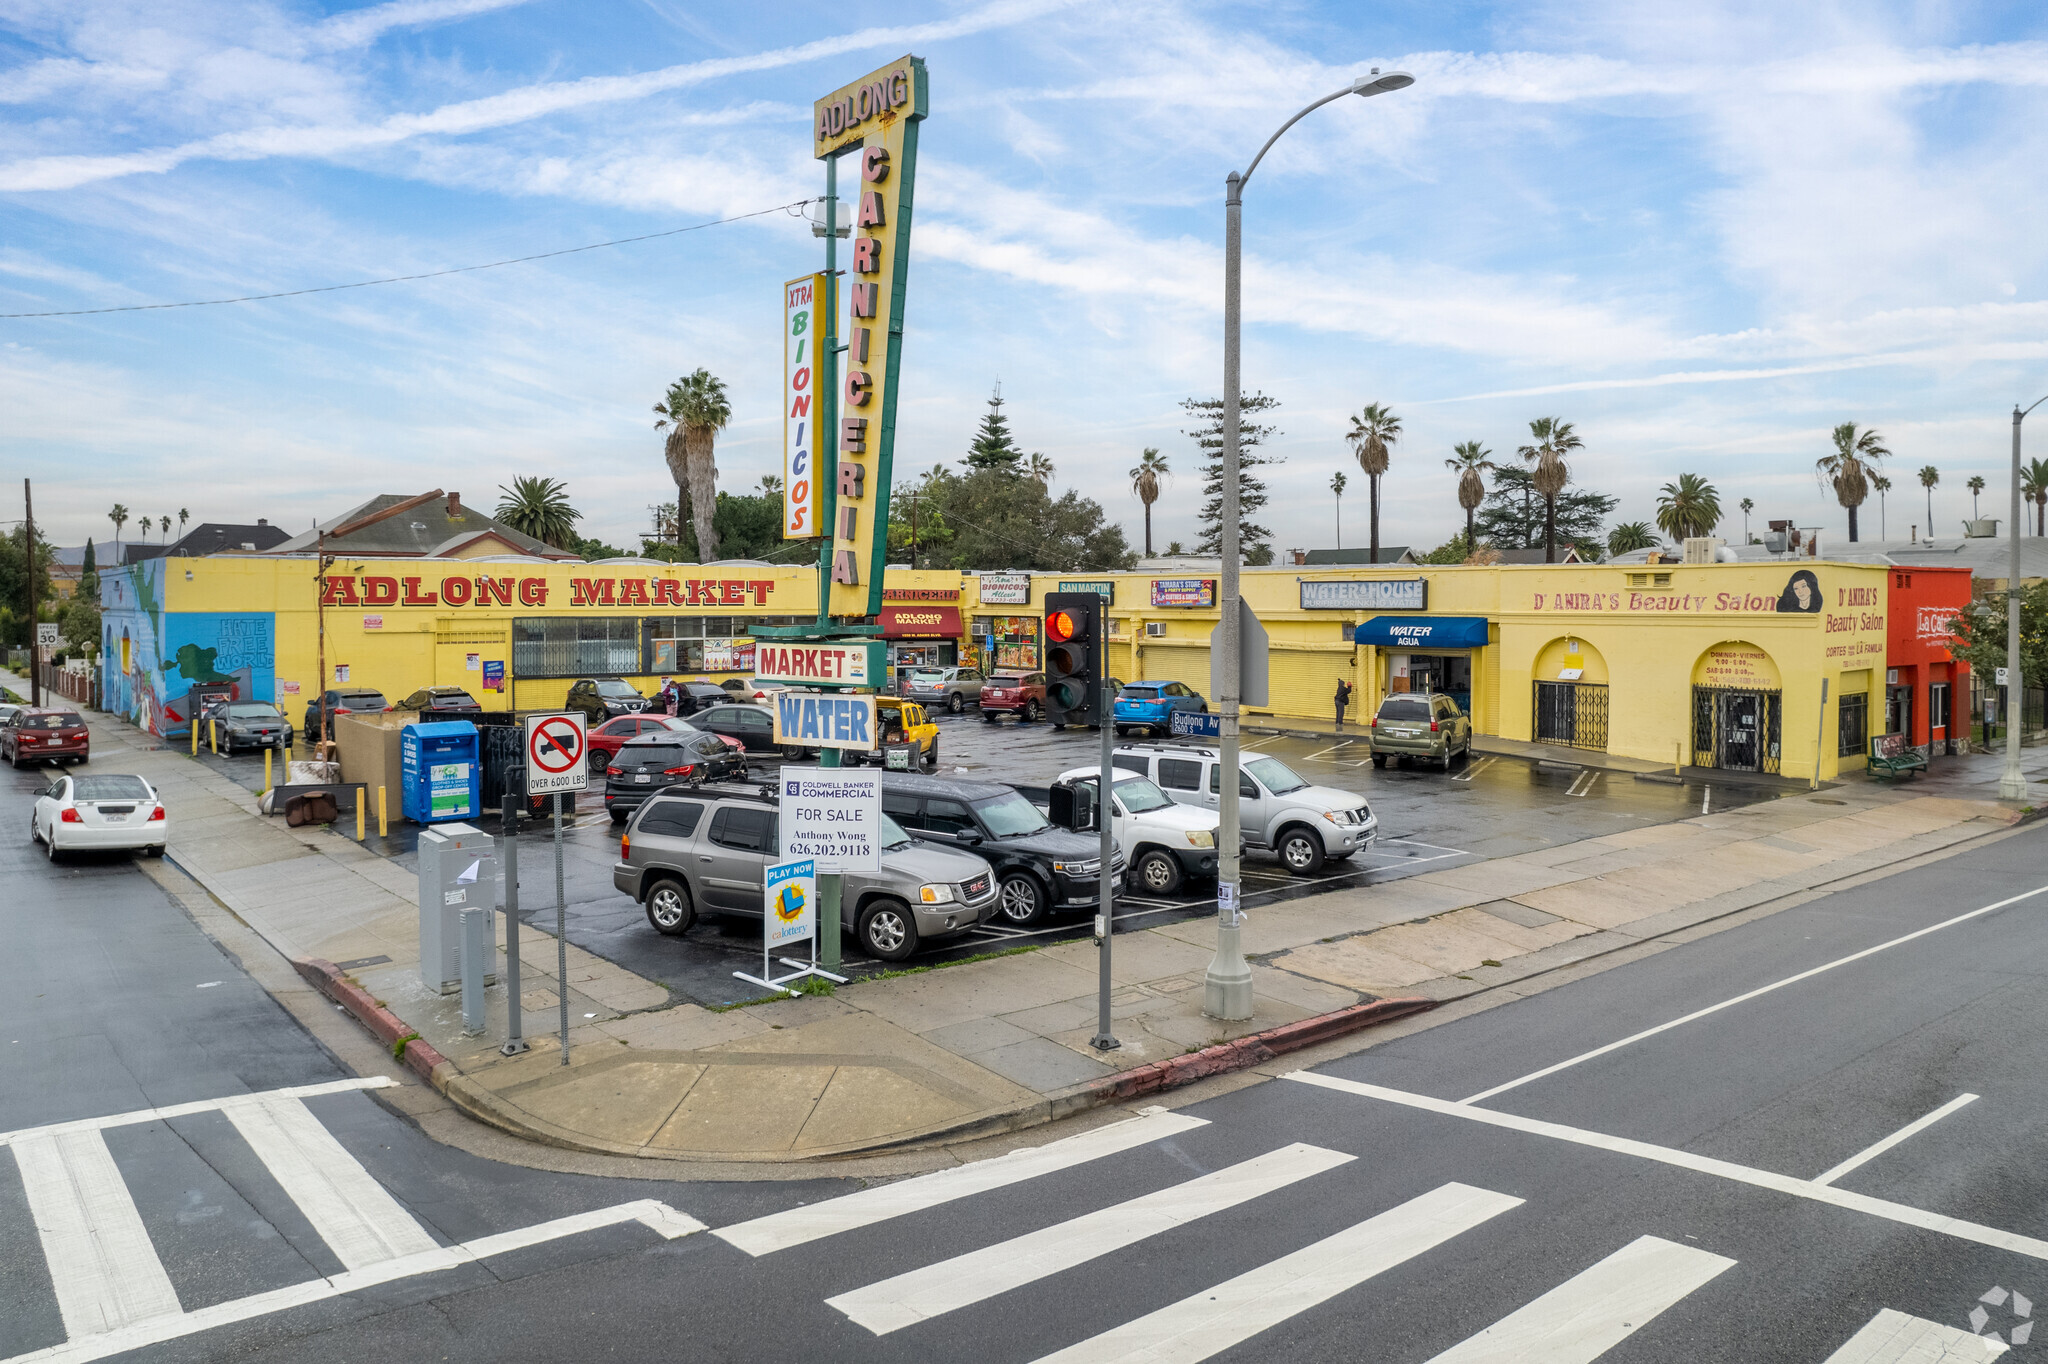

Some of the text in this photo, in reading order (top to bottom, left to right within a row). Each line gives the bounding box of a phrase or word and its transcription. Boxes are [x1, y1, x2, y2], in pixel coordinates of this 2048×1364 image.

[817, 69, 907, 142] ADLONG
[789, 284, 813, 309] XTRA
[830, 145, 890, 585] CARNICERIA
[790, 310, 812, 532] BIONICOS
[322, 576, 775, 607] ADLONG MARKET
[1061, 583, 1109, 593] SAN MARTIN
[1185, 580, 1201, 588] STORE
[1302, 582, 1423, 599] WATER HOUSE
[1342, 599, 1387, 607] DRINKING
[1389, 599, 1420, 607] WATER
[1553, 593, 1620, 611] ANIRA'S
[1628, 593, 1707, 612] Beauty
[1714, 593, 1776, 612] Salon
[1848, 587, 1878, 607] ANIRA'S
[220, 618, 266, 636] HATE
[1826, 612, 1884, 635] Beauty Salon
[1919, 612, 1930, 632] La
[40, 635, 56, 643] 30
[1389, 626, 1433, 636] WATER
[217, 637, 268, 655] FREE
[1397, 638, 1420, 646] AGUA
[1864, 643, 1883, 654] FAMILIA
[1826, 645, 1847, 658] CORTES
[215, 654, 275, 670] WORLD
[761, 648, 846, 678] MARKET
[779, 698, 869, 743] WATER
[1174, 713, 1219, 730] Budlong Av
[531, 779, 548, 789] OVER
[572, 775, 585, 785] LBS
[802, 789, 874, 798] COMMERCIAL
[796, 808, 863, 821] FOR SALE
[793, 830, 866, 842] Anthony Wong
[790, 843, 870, 855] 626.202.9118
[768, 863, 812, 880] PLAY NOW
